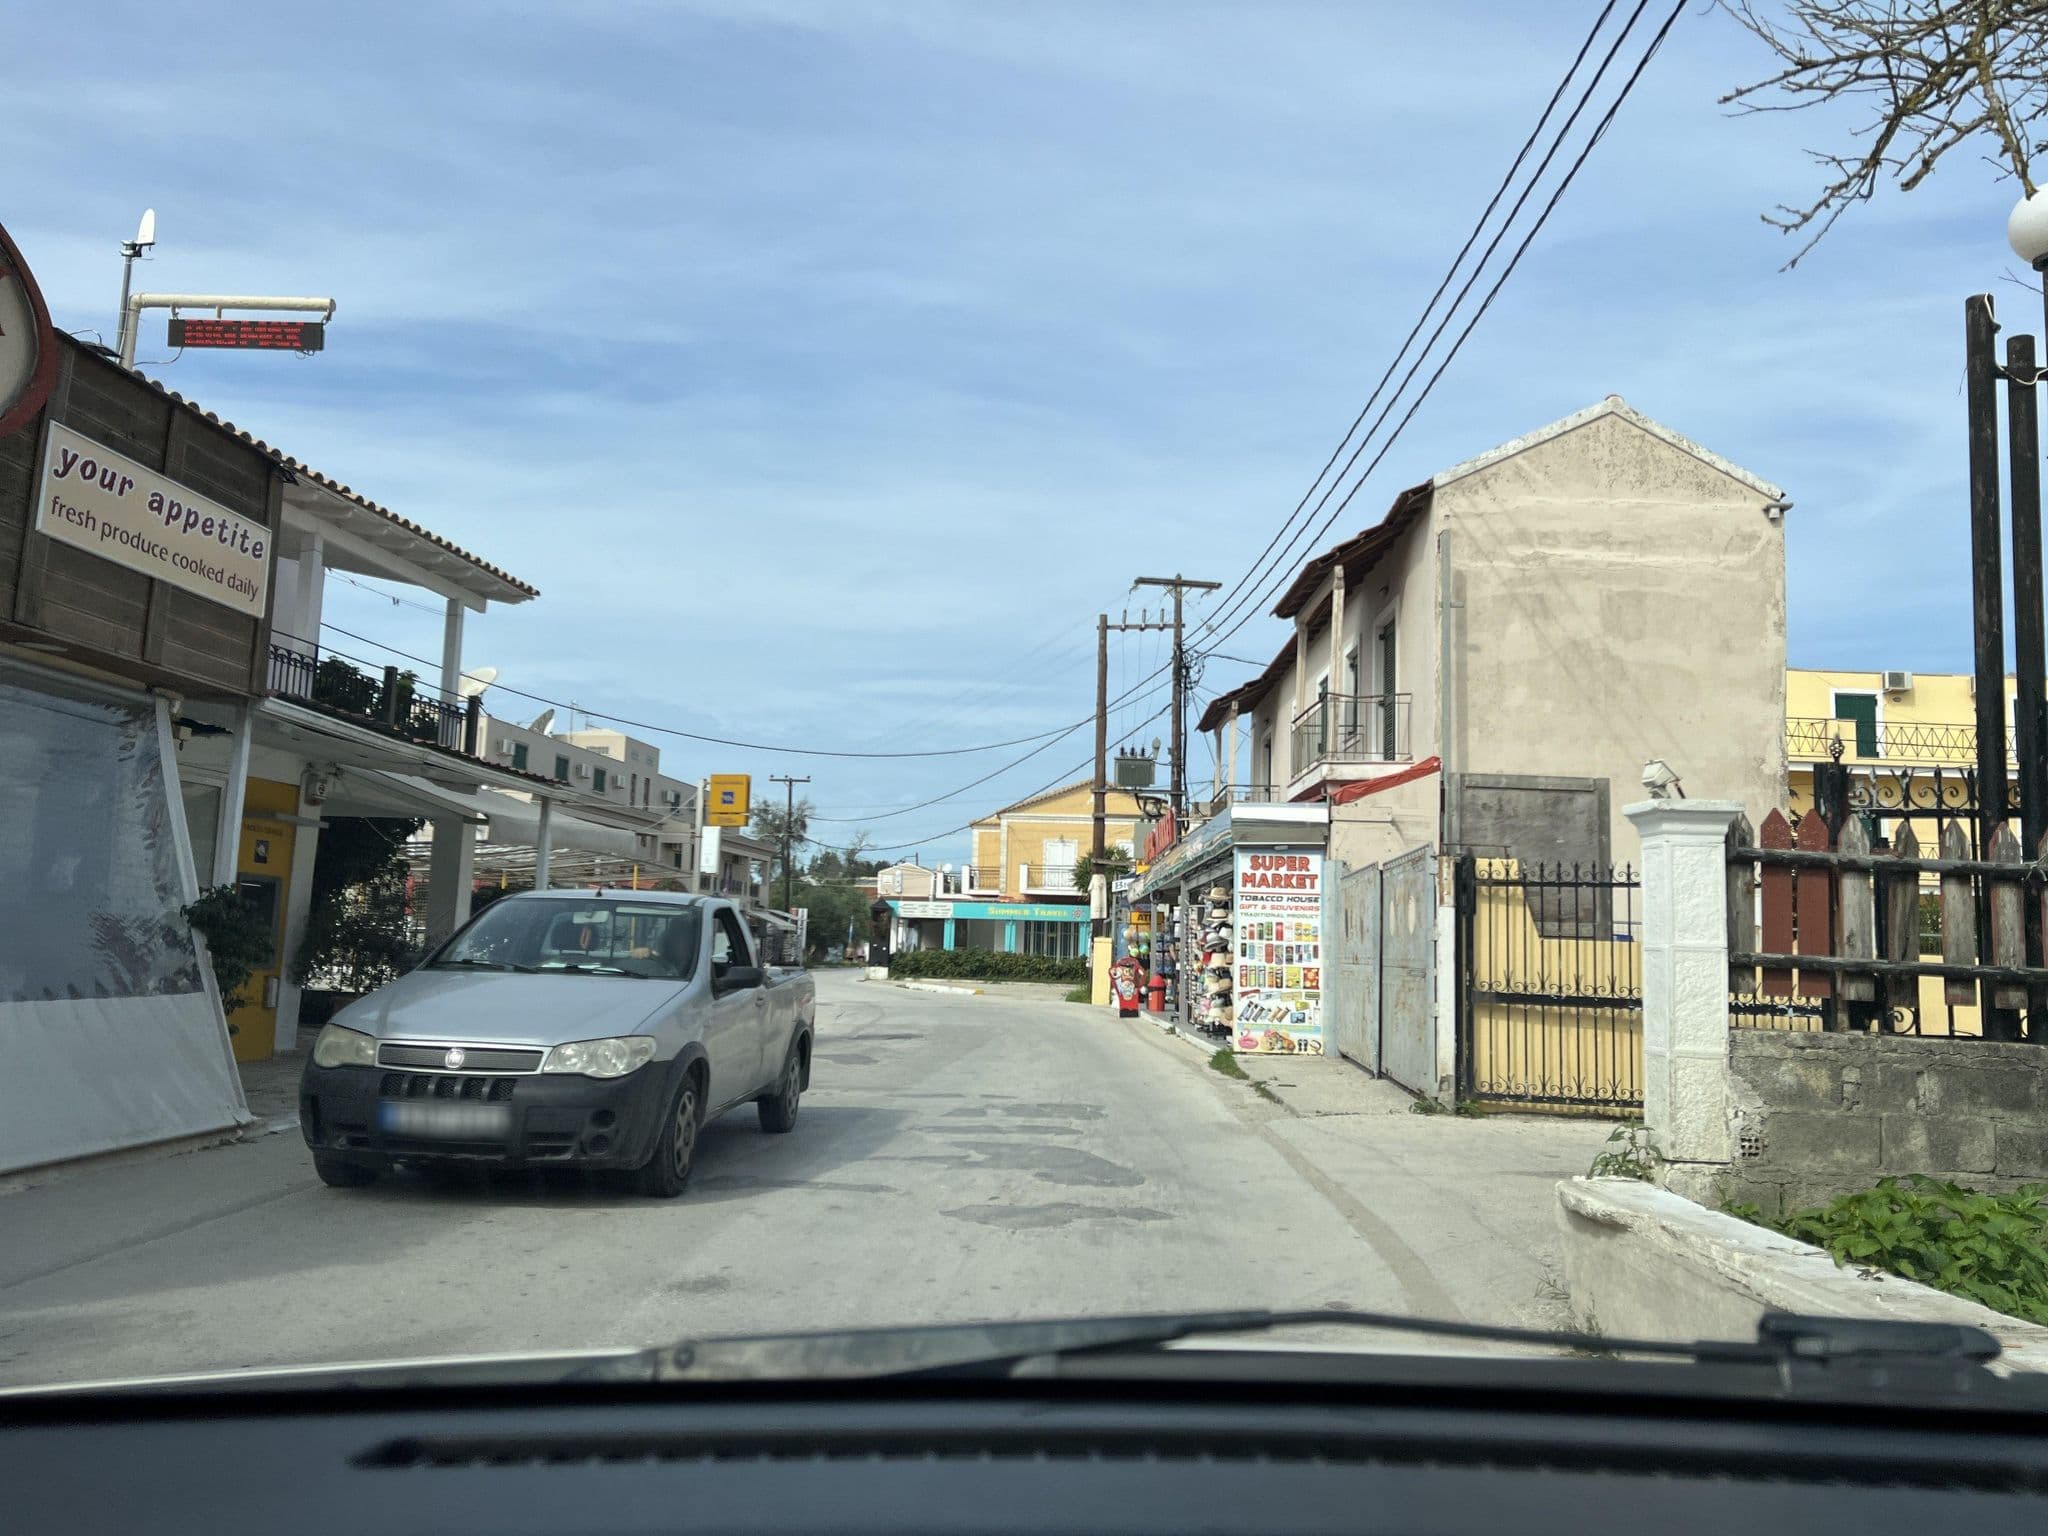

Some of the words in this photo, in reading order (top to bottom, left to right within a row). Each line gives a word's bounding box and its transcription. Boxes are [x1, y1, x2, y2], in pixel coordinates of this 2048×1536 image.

[52, 447, 134, 497] your
[147, 491, 264, 559] appetite
[50, 495, 97, 531] fresh
[100, 522, 169, 562] produce
[171, 550, 225, 584] cooked
[226, 572, 260, 602] daily
[1249, 854, 1311, 872] SUPER
[1241, 872, 1319, 889] MARKET
[1239, 894, 1284, 903] TOBACCO
[1239, 911, 1285, 919] TRADITIONAL
[1270, 904, 1320, 912] SOUVENIRS
